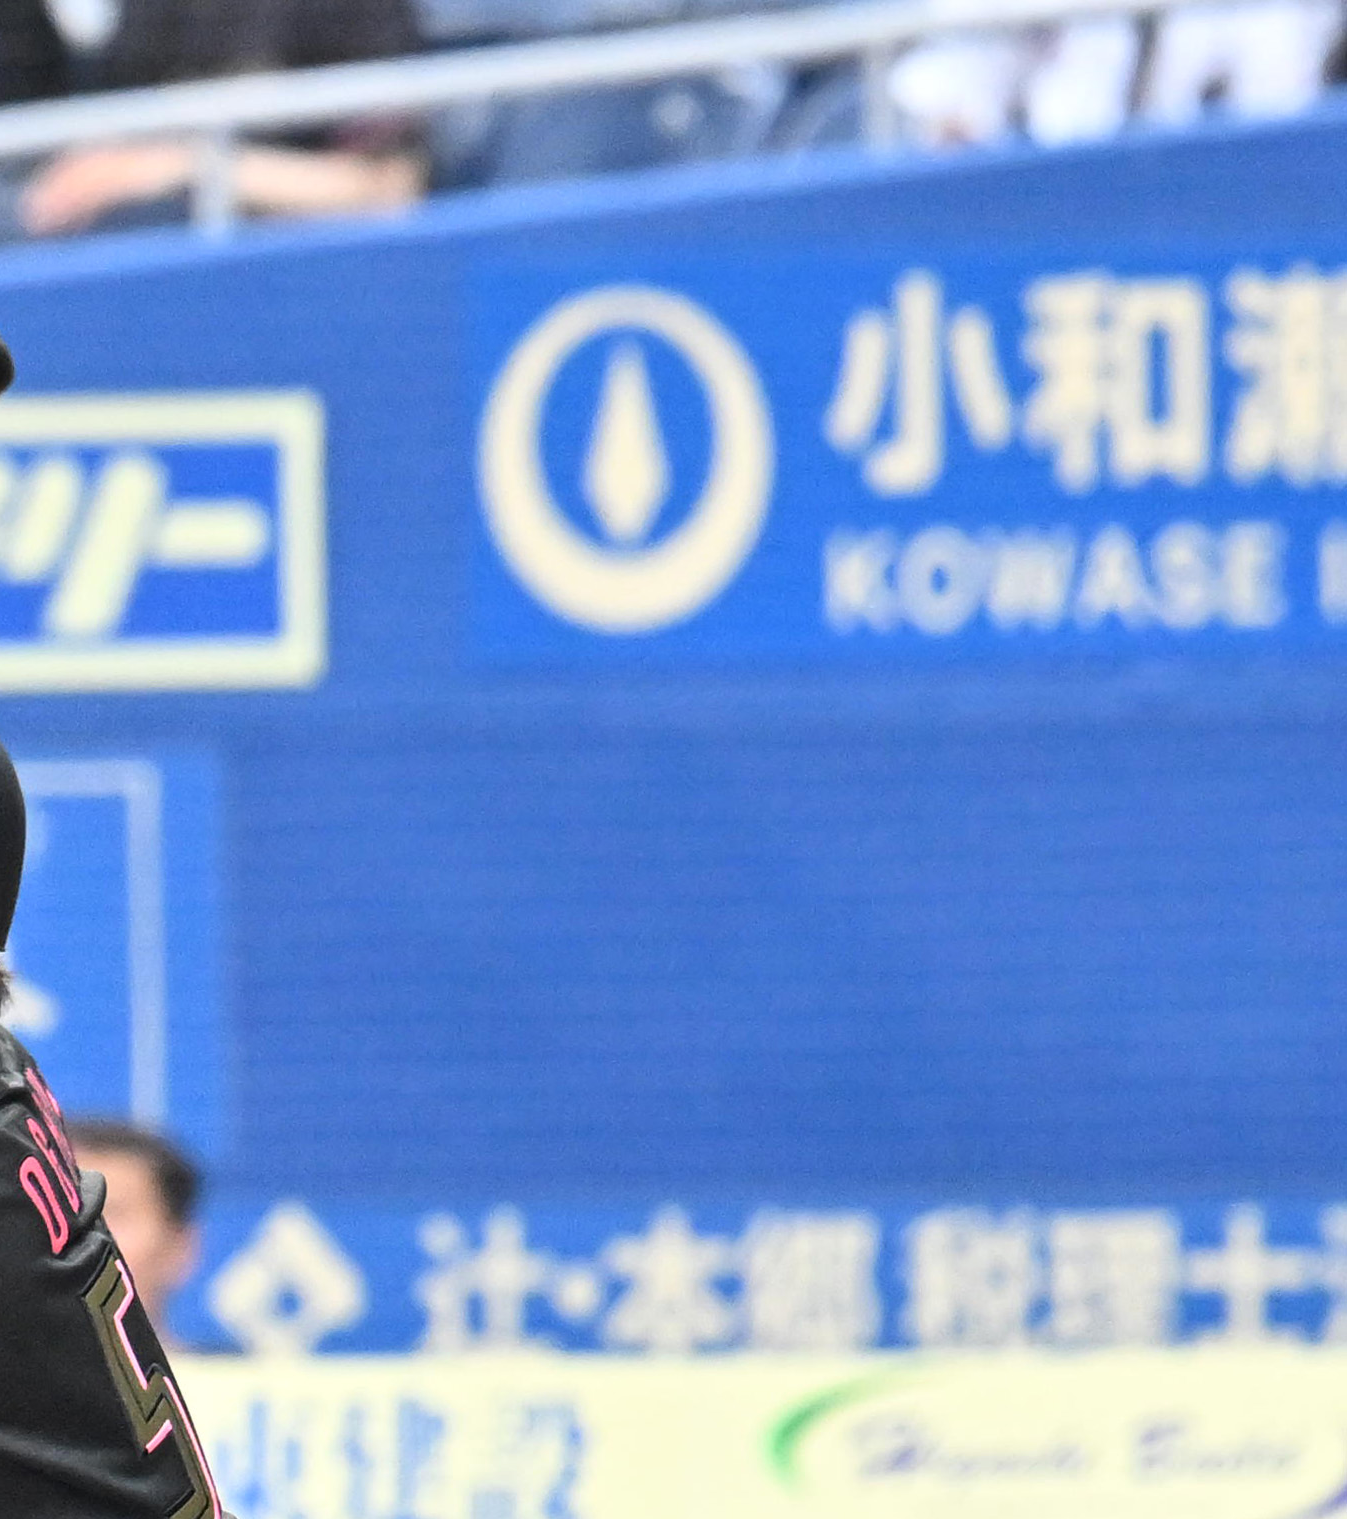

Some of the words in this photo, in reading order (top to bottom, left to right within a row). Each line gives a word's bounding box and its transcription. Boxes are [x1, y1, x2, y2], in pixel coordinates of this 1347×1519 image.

[822, 525, 1287, 632] KOWASE
[904, 1206, 1347, 1350] 税理士
